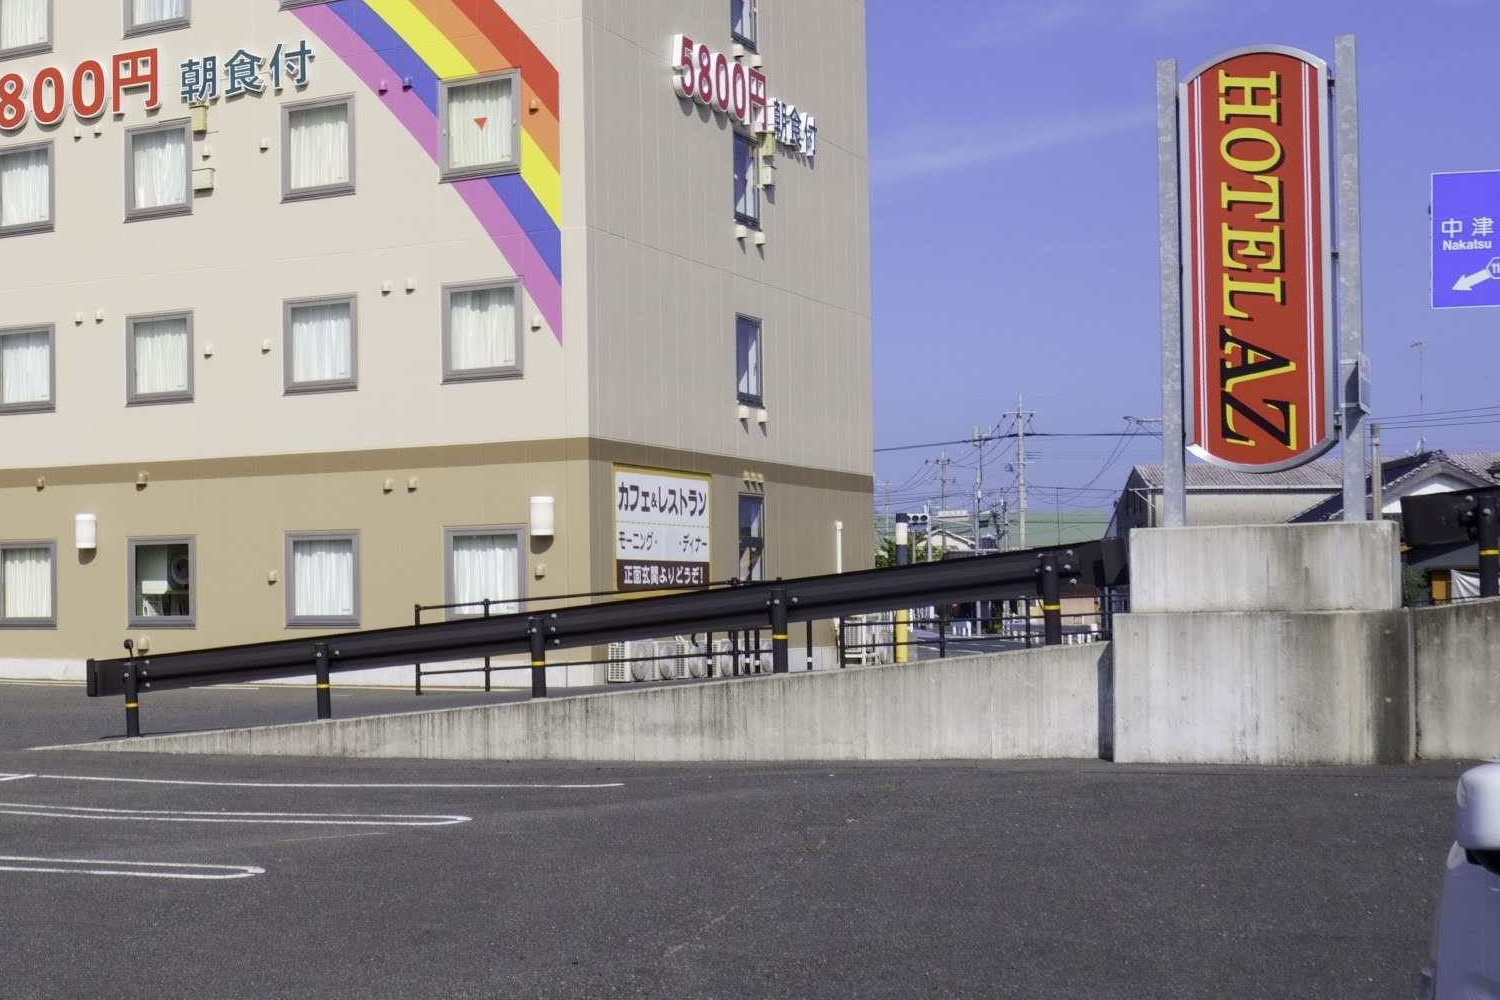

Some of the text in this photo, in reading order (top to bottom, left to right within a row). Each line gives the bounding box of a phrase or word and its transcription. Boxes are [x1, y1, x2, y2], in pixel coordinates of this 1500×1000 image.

[180, 40, 313, 103] 朝食付
[674, 34, 768, 132] 5800円
[1218, 69, 1297, 451] HOTEL AZ
[1442, 239, 1493, 251] Nakatsu
[618, 482, 706, 516] カフェ&レストラン
